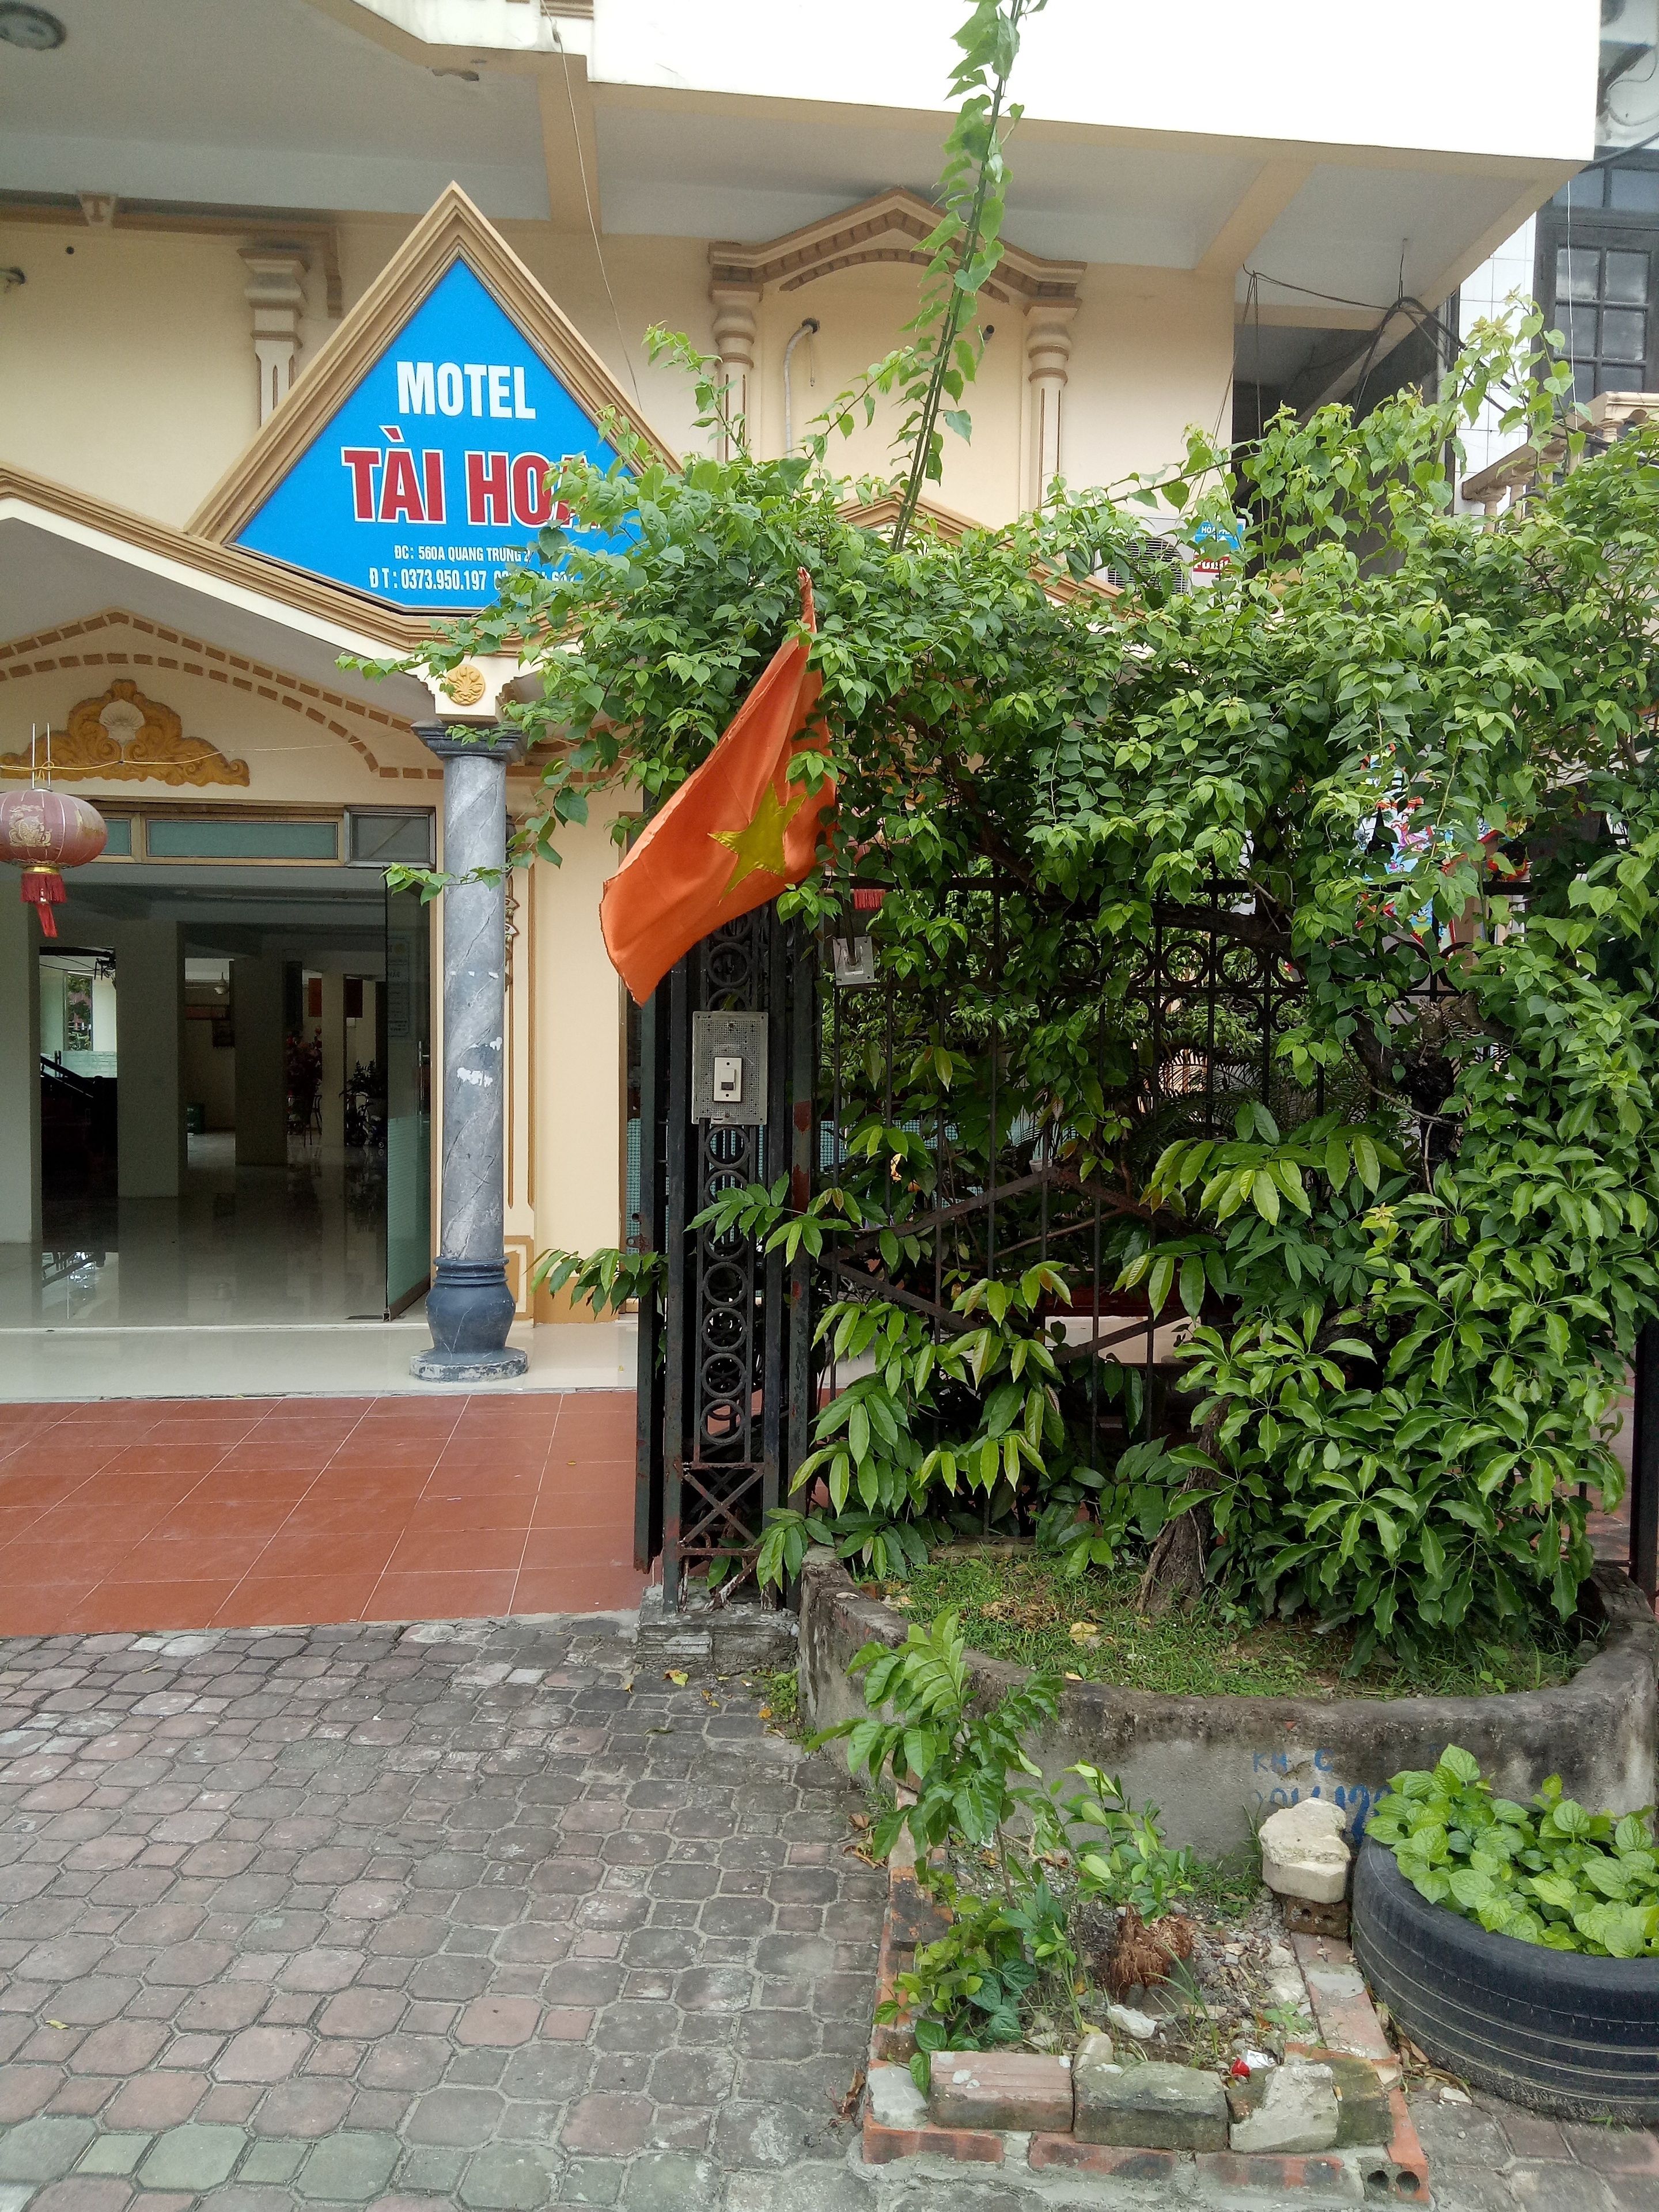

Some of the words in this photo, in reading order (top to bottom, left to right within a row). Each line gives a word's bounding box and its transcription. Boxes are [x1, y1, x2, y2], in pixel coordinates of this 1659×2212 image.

[396, 361, 536, 419] MOTEL
[340, 425, 446, 525] TÀI
[418, 546, 445, 560] 560A
[448, 546, 484, 562] QUANG
[486, 547, 522, 562] TRUNG
[400, 568, 487, 590] 0373.950.197
